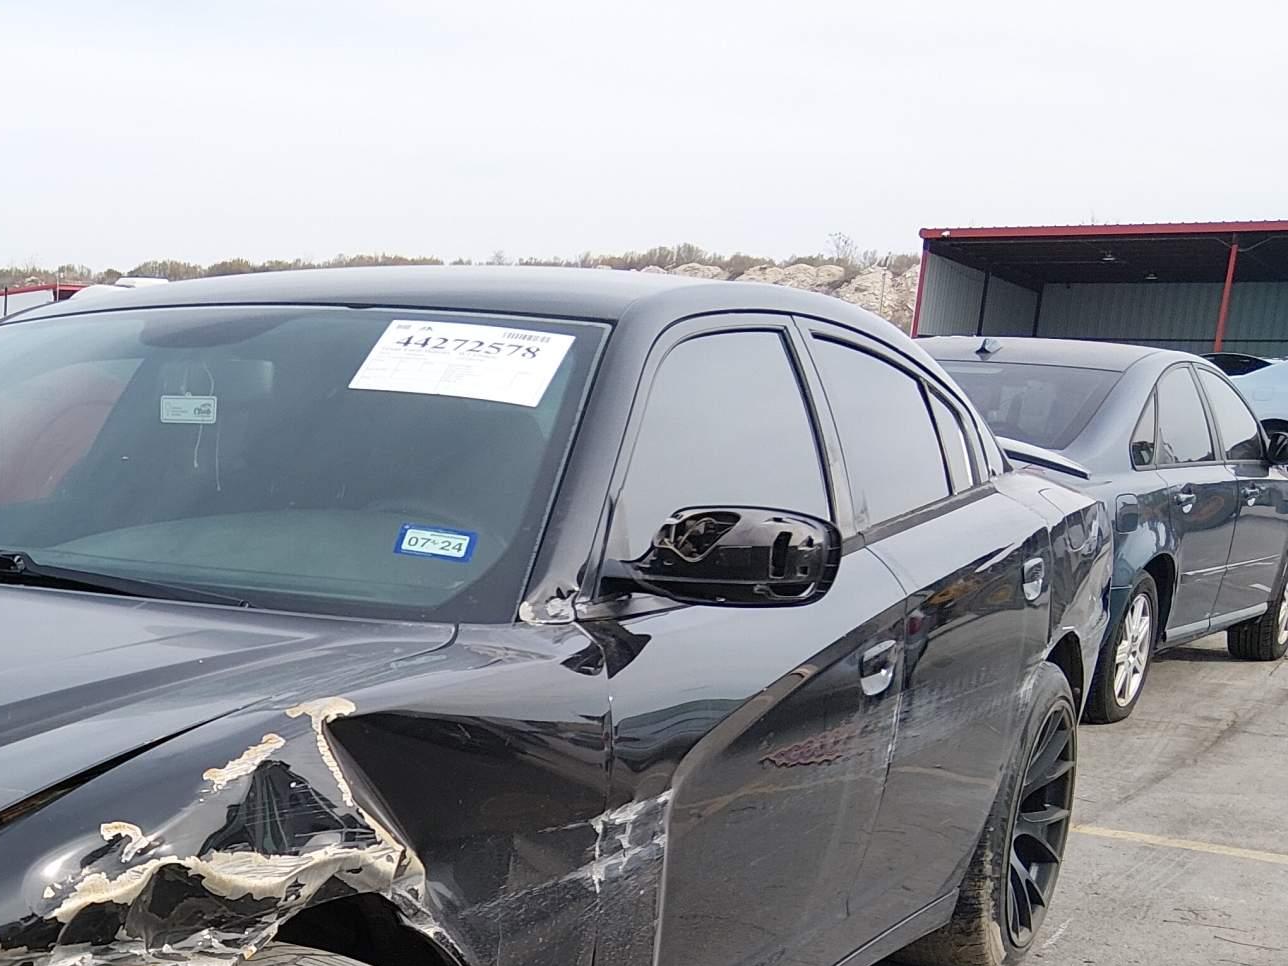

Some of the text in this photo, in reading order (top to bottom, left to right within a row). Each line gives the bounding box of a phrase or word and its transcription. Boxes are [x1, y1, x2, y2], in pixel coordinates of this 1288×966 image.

[396, 334, 541, 360] 44272578
[407, 536, 431, 548] 07
[439, 540, 464, 553] 24
